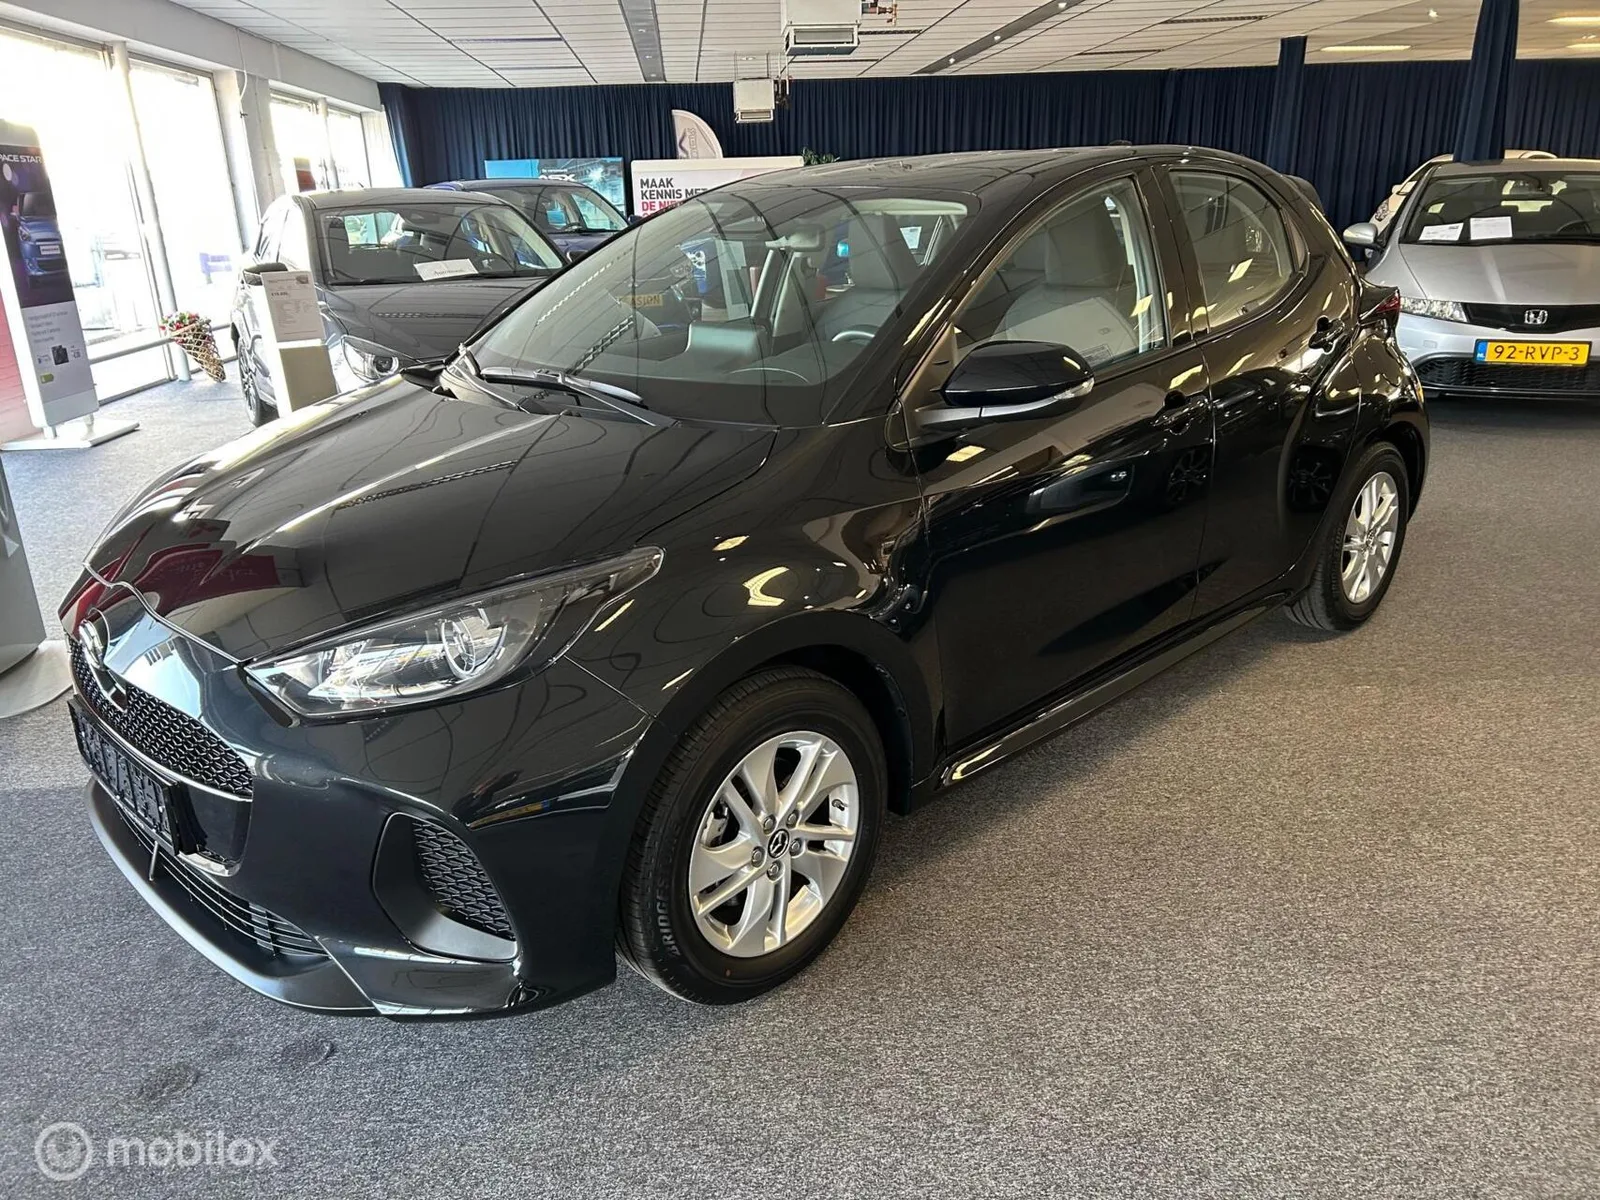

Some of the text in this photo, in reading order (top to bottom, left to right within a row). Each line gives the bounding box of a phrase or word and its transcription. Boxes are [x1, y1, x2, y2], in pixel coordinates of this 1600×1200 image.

[640, 177, 674, 189] MAAK
[641, 188, 708, 200] KENNIS ME
[641, 201, 656, 212] DE
[1494, 345, 1580, 361] 92-RVP-3
